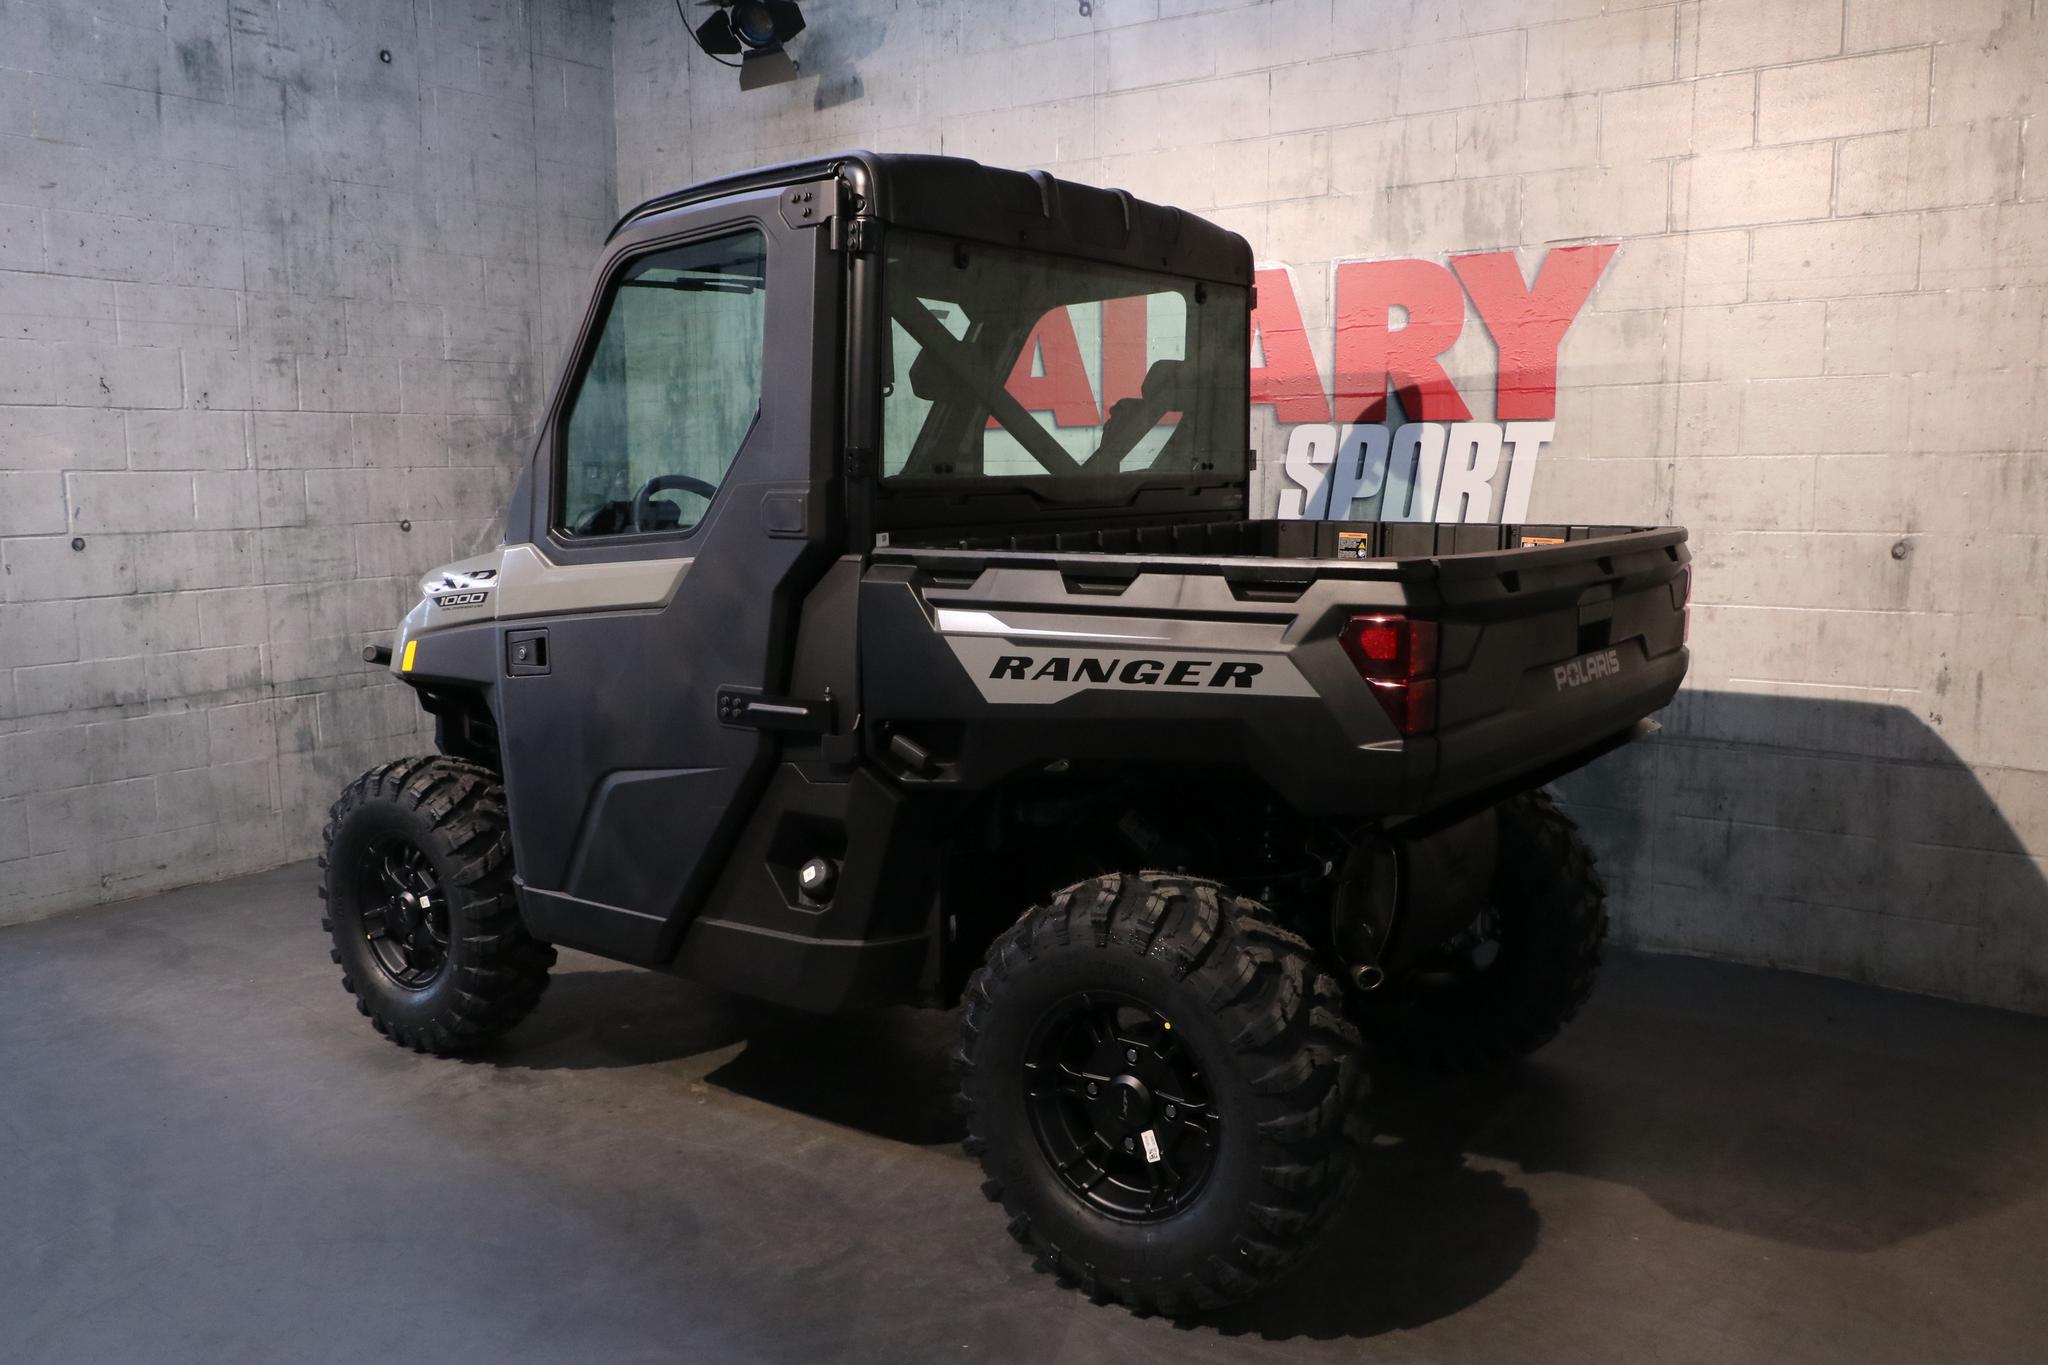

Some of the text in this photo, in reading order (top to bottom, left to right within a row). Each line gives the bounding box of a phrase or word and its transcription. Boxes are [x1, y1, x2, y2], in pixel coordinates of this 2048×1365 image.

[1278, 421, 1555, 524] SPORT
[440, 593, 485, 606] 1000
[988, 655, 1264, 689] RANGER
[1553, 649, 1620, 691] POLARIS
